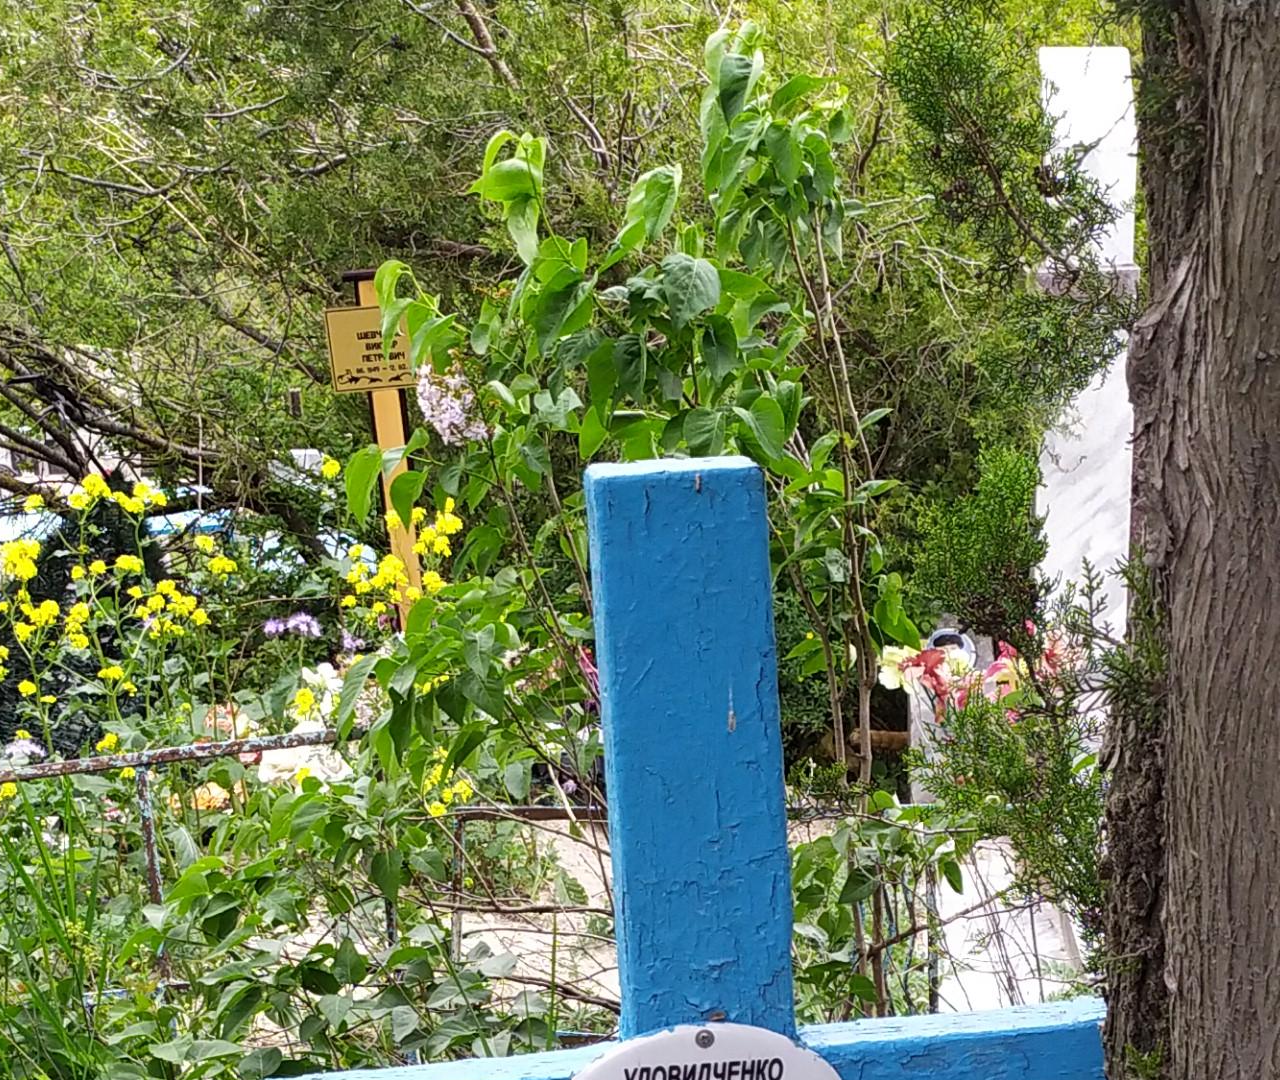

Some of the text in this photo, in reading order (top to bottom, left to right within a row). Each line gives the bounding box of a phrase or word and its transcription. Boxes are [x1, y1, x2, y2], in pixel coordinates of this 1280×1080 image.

[356, 330, 402, 340] ШЕВЧ
[365, 340, 398, 350] ВИКР
[362, 351, 406, 362] ПЕТРВИЧ
